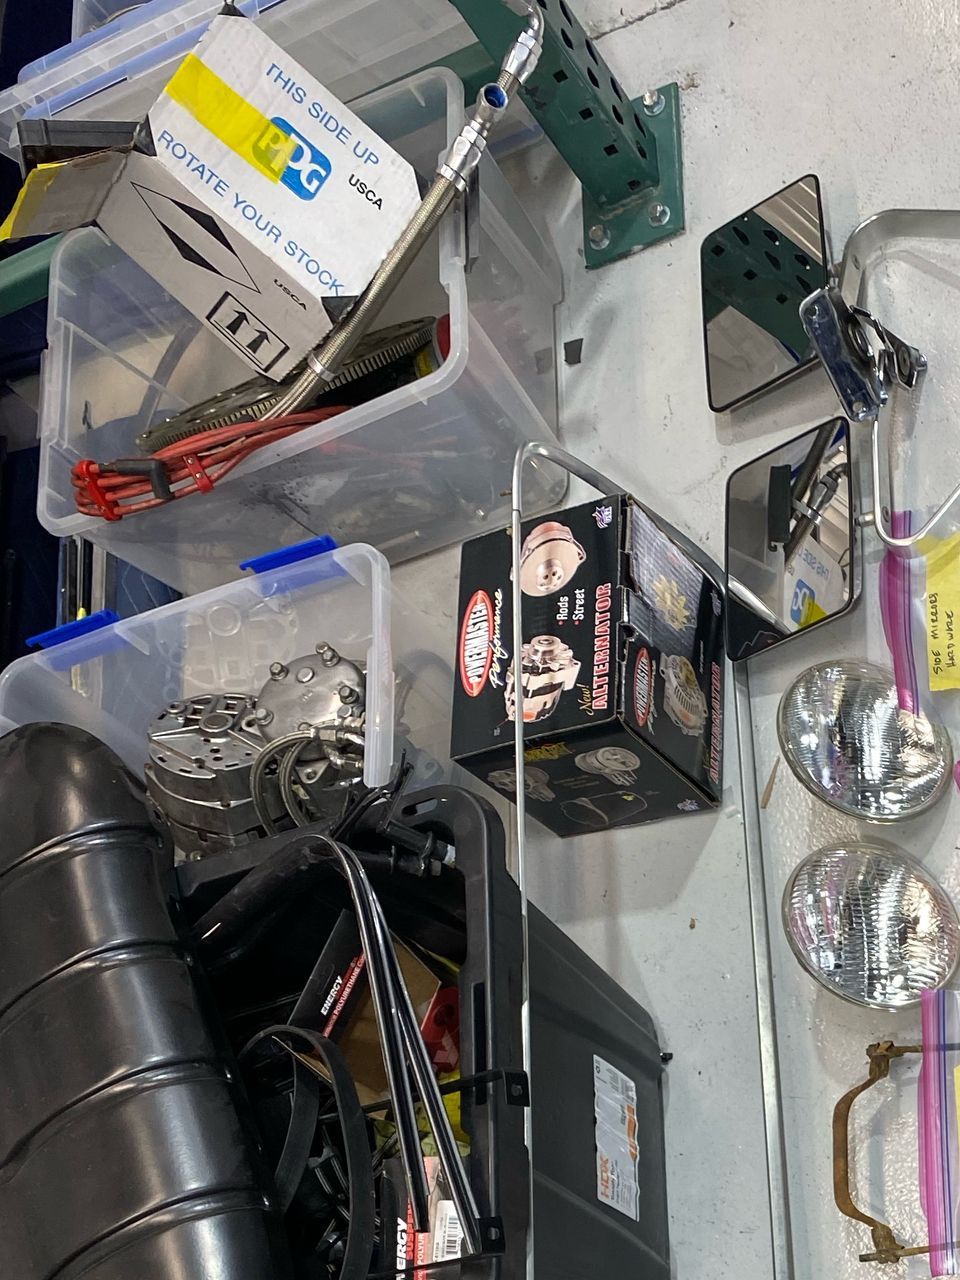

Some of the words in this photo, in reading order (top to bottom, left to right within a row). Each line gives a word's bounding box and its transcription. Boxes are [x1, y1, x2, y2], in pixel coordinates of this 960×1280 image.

[266, 62, 307, 105] THIS
[307, 101, 352, 145] SIDE
[353, 140, 380, 169] UP
[255, 120, 328, 196] PPG
[157, 129, 230, 194] ROTATE
[233, 192, 282, 243] YOUR
[284, 240, 345, 297] STOCK
[348, 173, 383, 210] USCA
[273, 278, 308, 311] USCA
[556, 594, 569, 621] Rods
[573, 588, 585, 621] Street
[463, 598, 491, 685] POWERMASTER
[488, 588, 504, 690] Performance
[592, 582, 612, 710] ALTERNATOR
[931, 649, 943, 675] SIDE
[578, 682, 597, 717] New!
[633, 655, 649, 718] POWERMASTER
[709, 661, 720, 784] ALTERNATOR
[320, 974, 343, 1016] ENERGY
[332, 967, 361, 1016] POLYURETHANE
